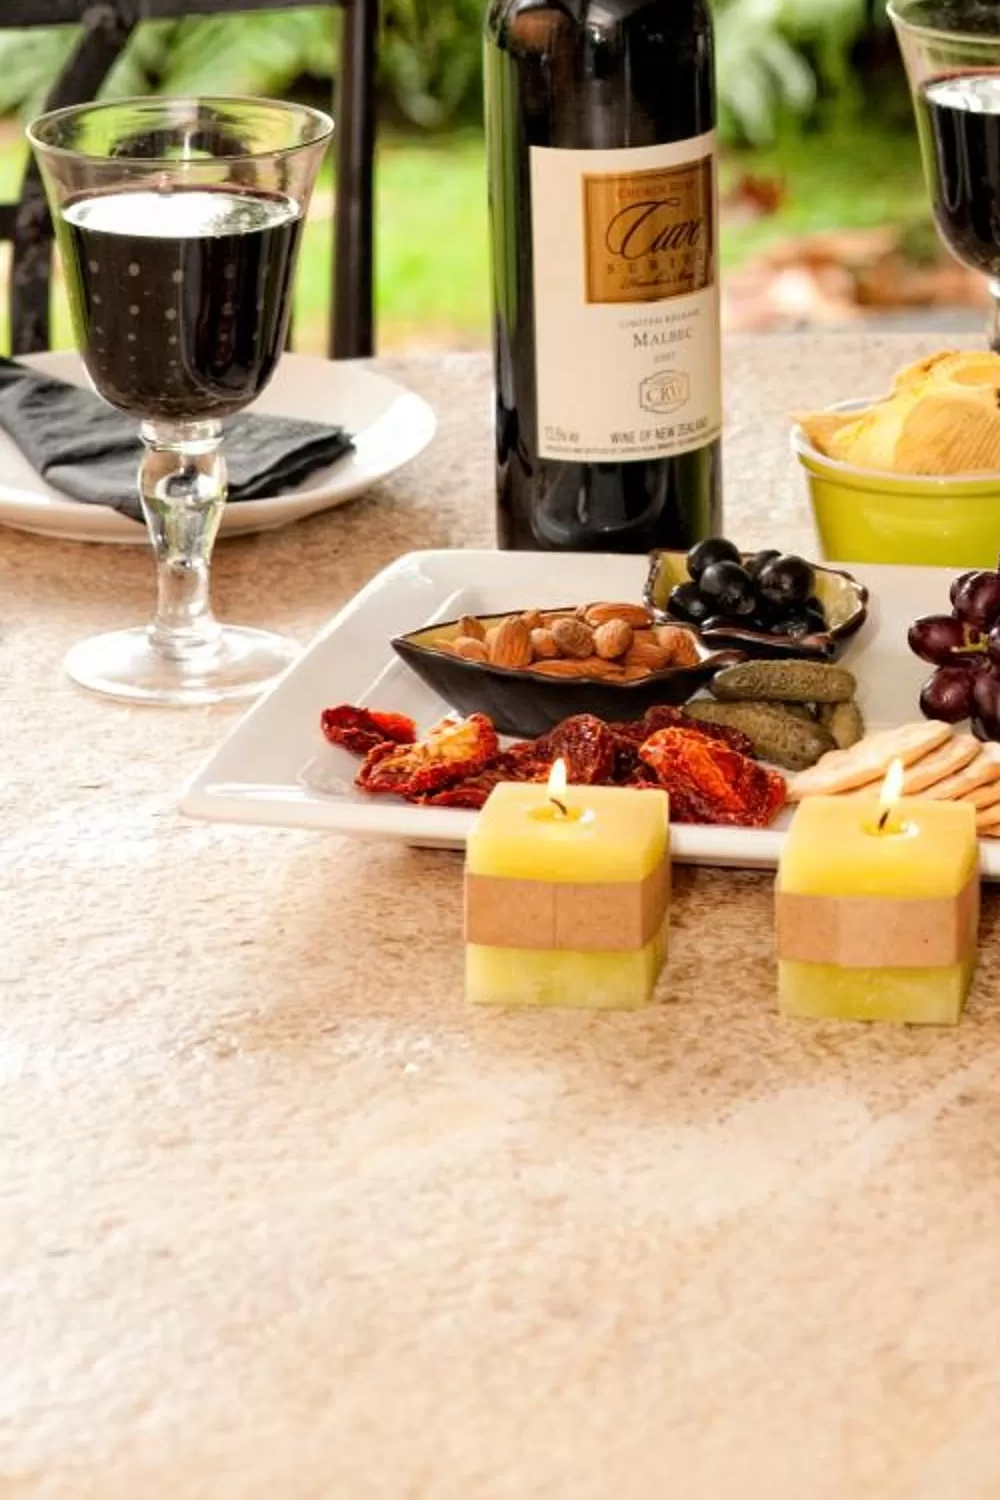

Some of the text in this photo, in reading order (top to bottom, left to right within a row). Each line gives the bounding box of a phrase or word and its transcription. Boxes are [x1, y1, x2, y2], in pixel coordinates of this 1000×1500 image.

[633, 328, 694, 348] MALBEC
[609, 430, 635, 444] WINE
[639, 428, 652, 443] OF
[655, 423, 675, 440] NEW
